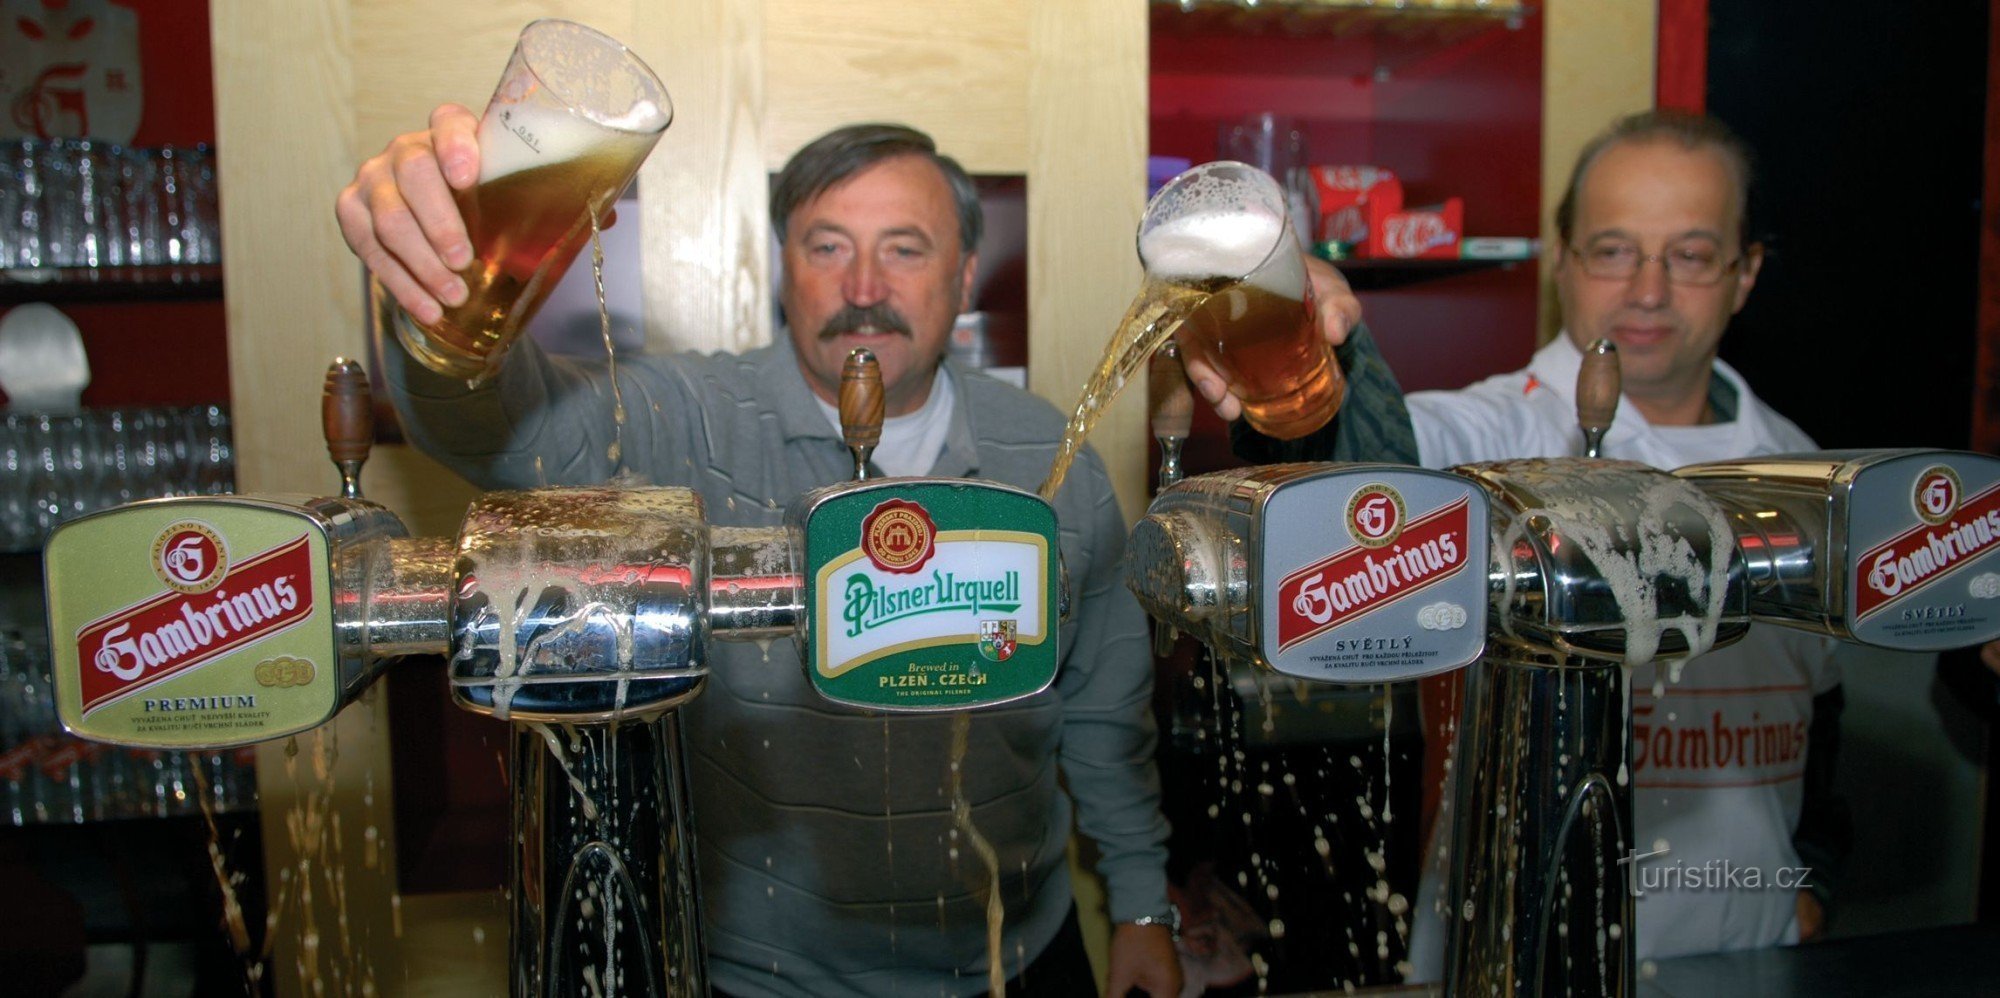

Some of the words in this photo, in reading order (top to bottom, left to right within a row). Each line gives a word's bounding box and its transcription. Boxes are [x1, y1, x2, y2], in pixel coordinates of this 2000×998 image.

[1868, 508, 2000, 596] Gambrinus
[1293, 533, 1458, 625] Gambrinus
[843, 572, 935, 638] Pilsner
[933, 568, 1019, 615] Urquell
[94, 575, 298, 681] Gambrinus
[1336, 634, 1413, 651] SVĚTLÝ
[908, 662, 946, 672] Brewed
[949, 662, 960, 671] in
[939, 673, 987, 685] CZECH
[896, 689, 909, 697] THE
[143, 694, 256, 712] PREMIUM
[238, 710, 271, 720] KVALITY
[148, 723, 181, 732] KVALITU
